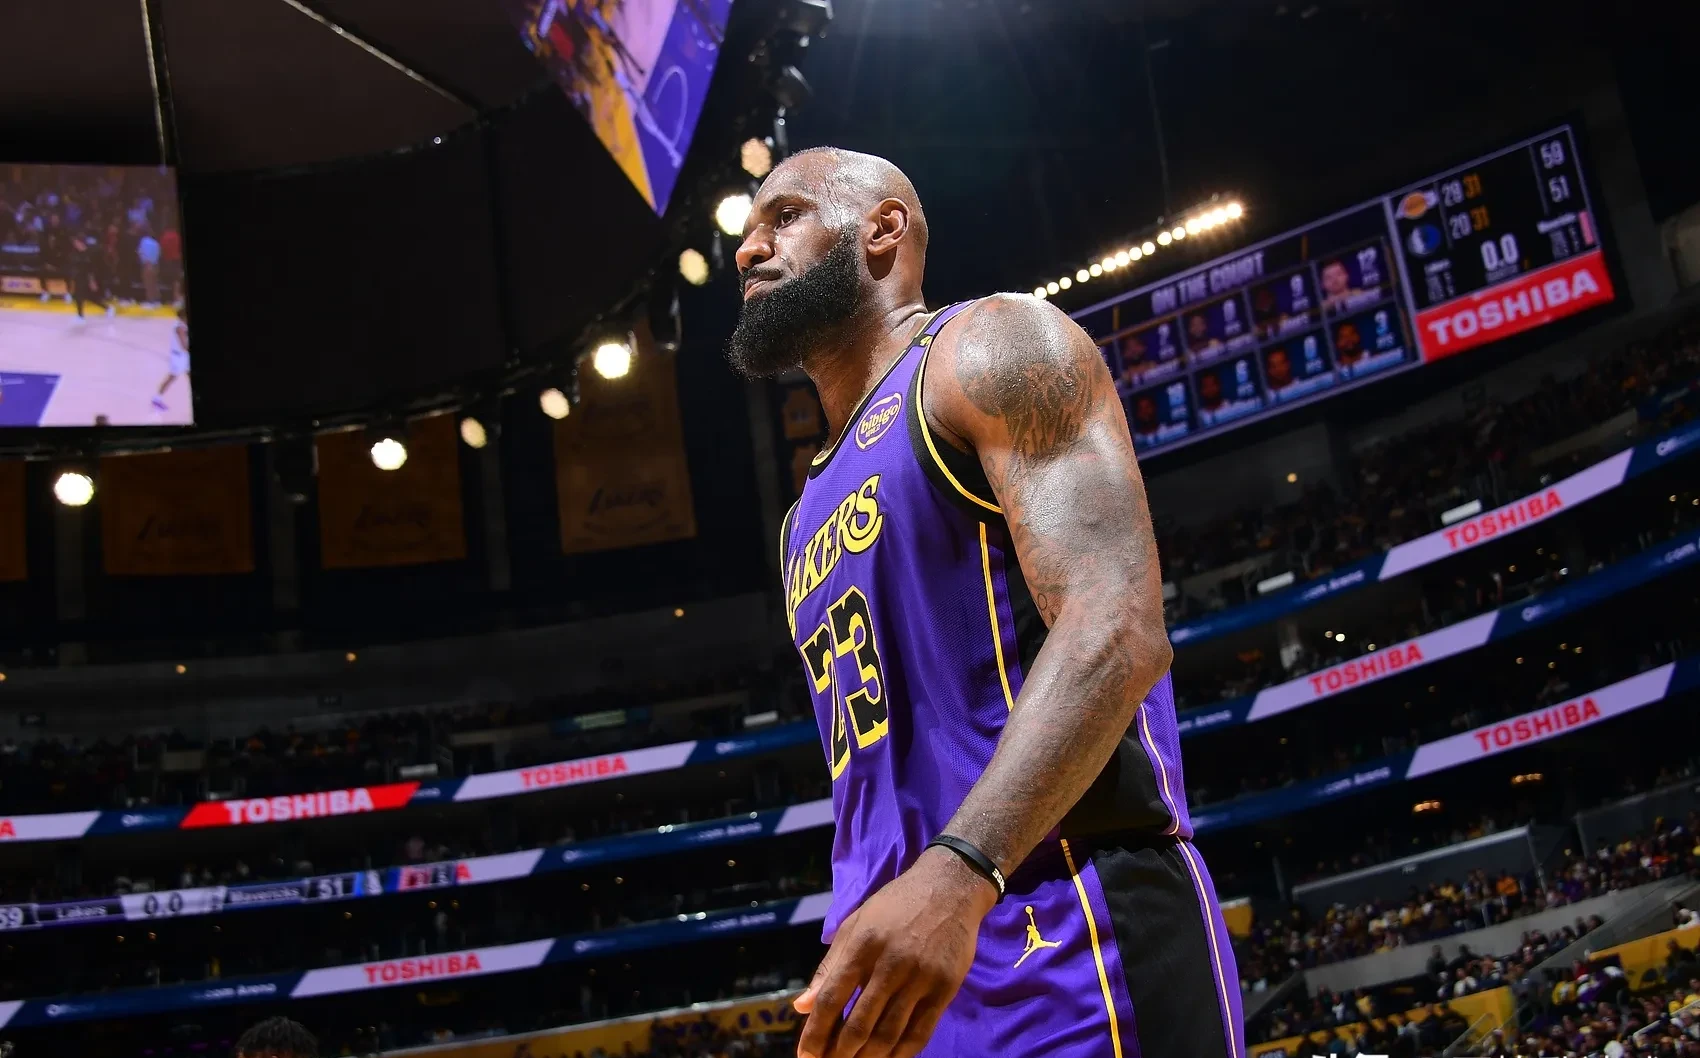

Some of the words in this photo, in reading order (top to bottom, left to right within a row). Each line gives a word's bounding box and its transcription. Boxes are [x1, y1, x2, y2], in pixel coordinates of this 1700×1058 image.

[1480, 233, 1519, 272] 0.0
[1428, 269, 1598, 345] TOSHIBA
[860, 404, 899, 434] bibigo
[1442, 489, 1563, 551] TOSHIBA
[800, 585, 889, 781] 23
[1308, 642, 1424, 696] TOSHIBA
[1474, 697, 1602, 753] TOSHIBA
[520, 755, 628, 789] TOSHIBA
[225, 787, 375, 825] TOSHIBA
[56, 905, 107, 920] Lakers
[144, 893, 183, 916] 0.0
[318, 877, 343, 900] 51
[363, 953, 481, 984] TOSHIBA
